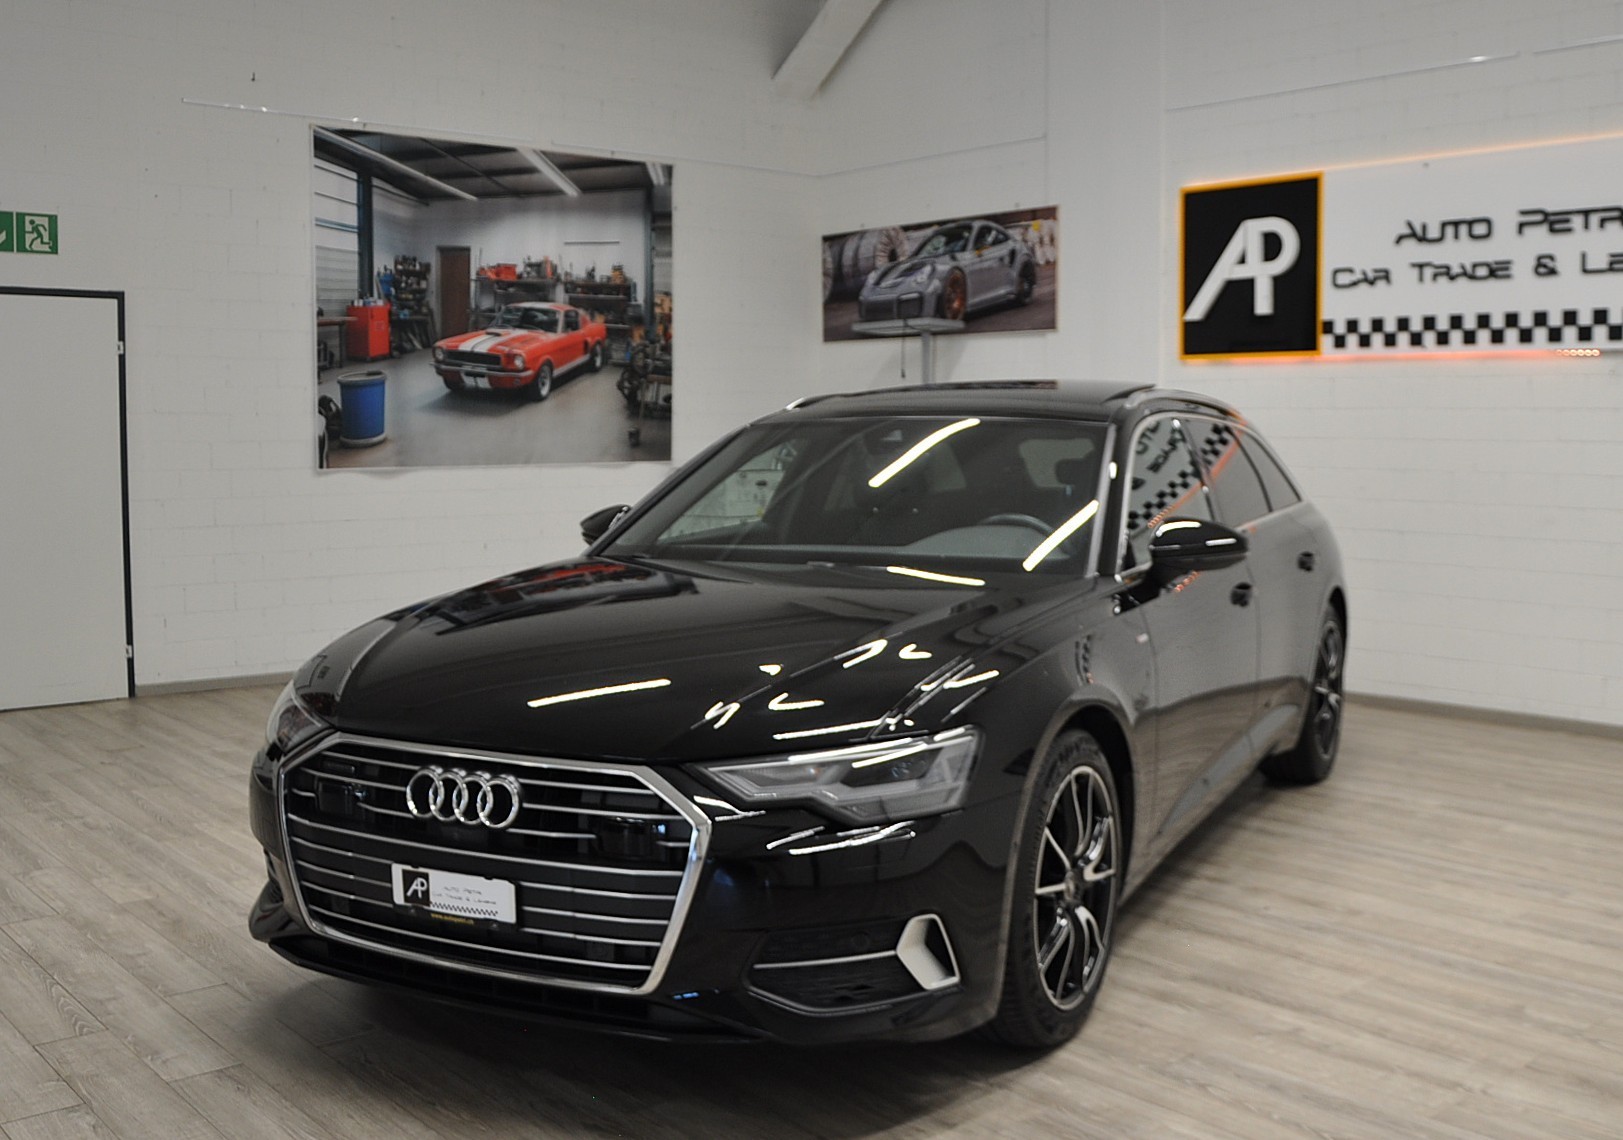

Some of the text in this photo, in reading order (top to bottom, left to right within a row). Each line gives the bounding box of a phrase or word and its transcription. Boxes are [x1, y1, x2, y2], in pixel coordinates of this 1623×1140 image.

[1395, 217, 1493, 245] AUTO
[1332, 266, 1391, 289] CAR
[1410, 259, 1513, 284] TRADE
[1534, 253, 1560, 277] &
